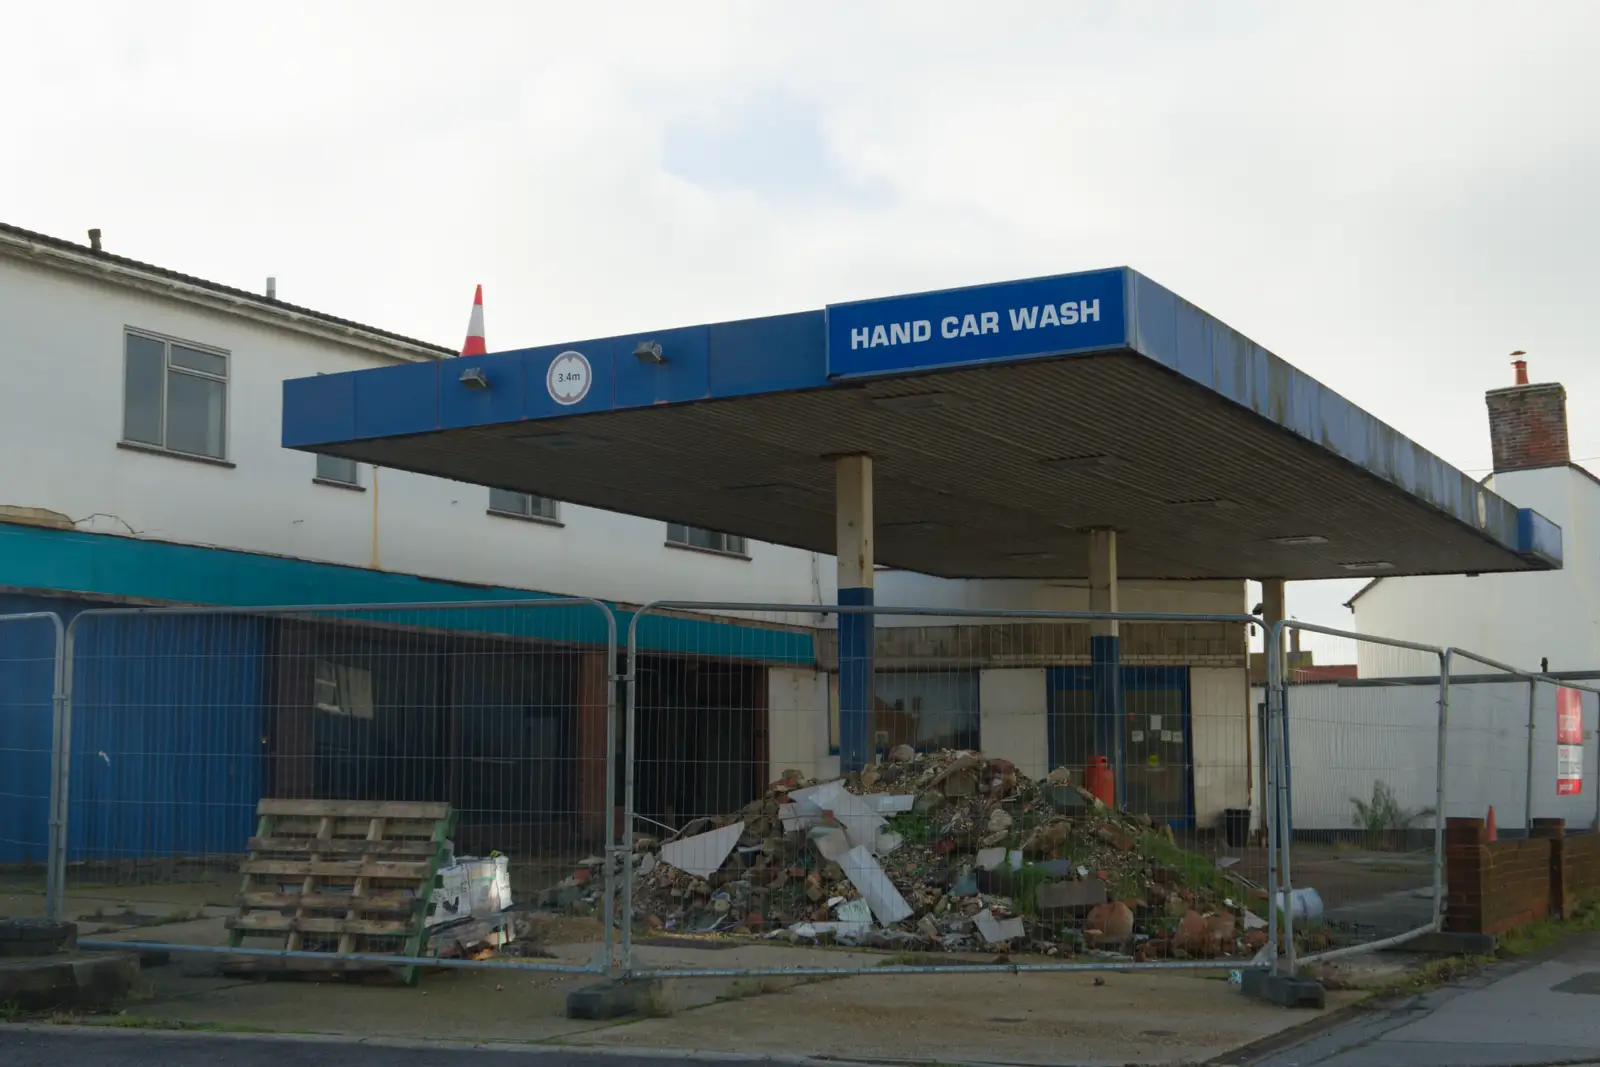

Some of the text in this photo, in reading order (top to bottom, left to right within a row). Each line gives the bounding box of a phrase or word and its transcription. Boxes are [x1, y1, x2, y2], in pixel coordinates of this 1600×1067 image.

[851, 298, 1100, 350] HAND CAR WASH
[558, 372, 581, 383] 3.4m
